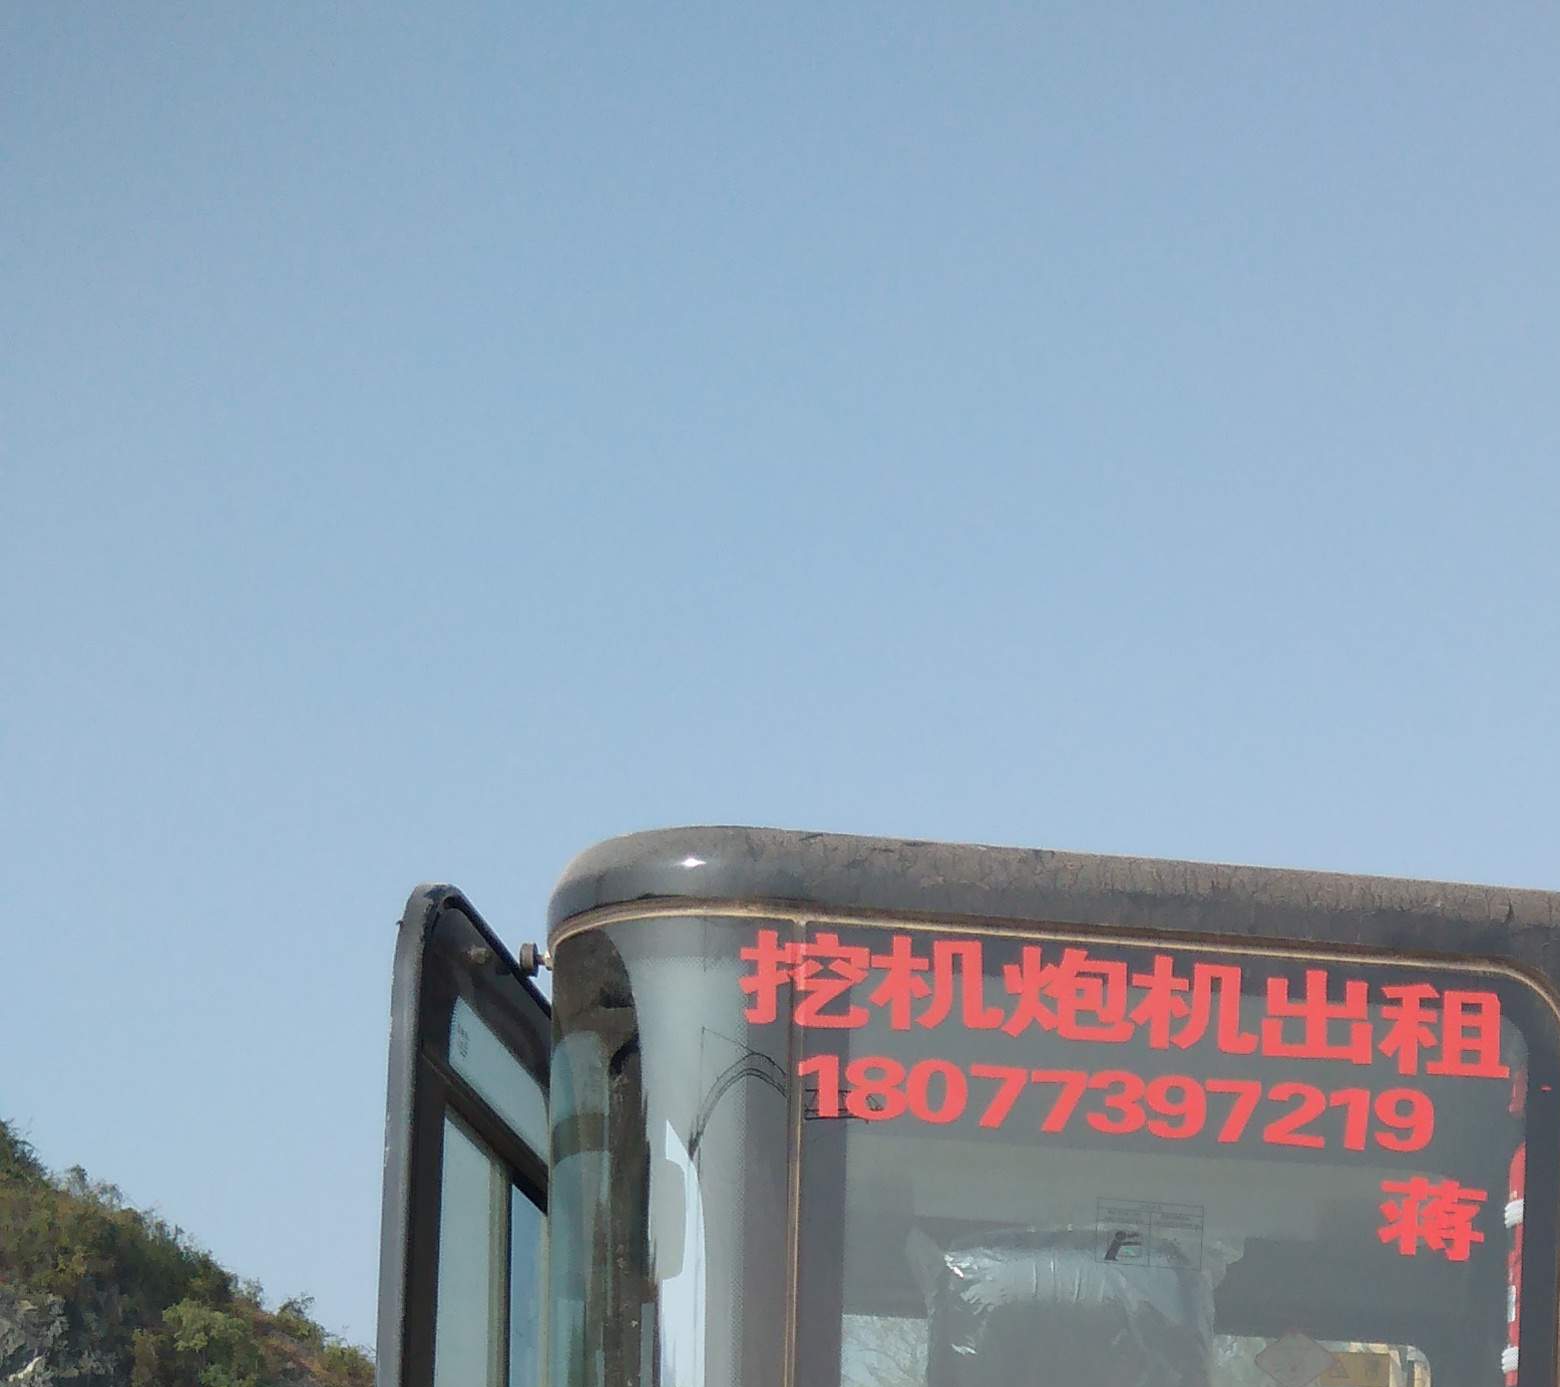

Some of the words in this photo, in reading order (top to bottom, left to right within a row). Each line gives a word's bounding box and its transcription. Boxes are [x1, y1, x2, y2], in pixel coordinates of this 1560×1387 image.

[739, 929, 1510, 1079] 挖机炮机出租
[798, 1054, 1435, 1152] 18077397219
[1376, 1176, 1487, 1261] 蒋
